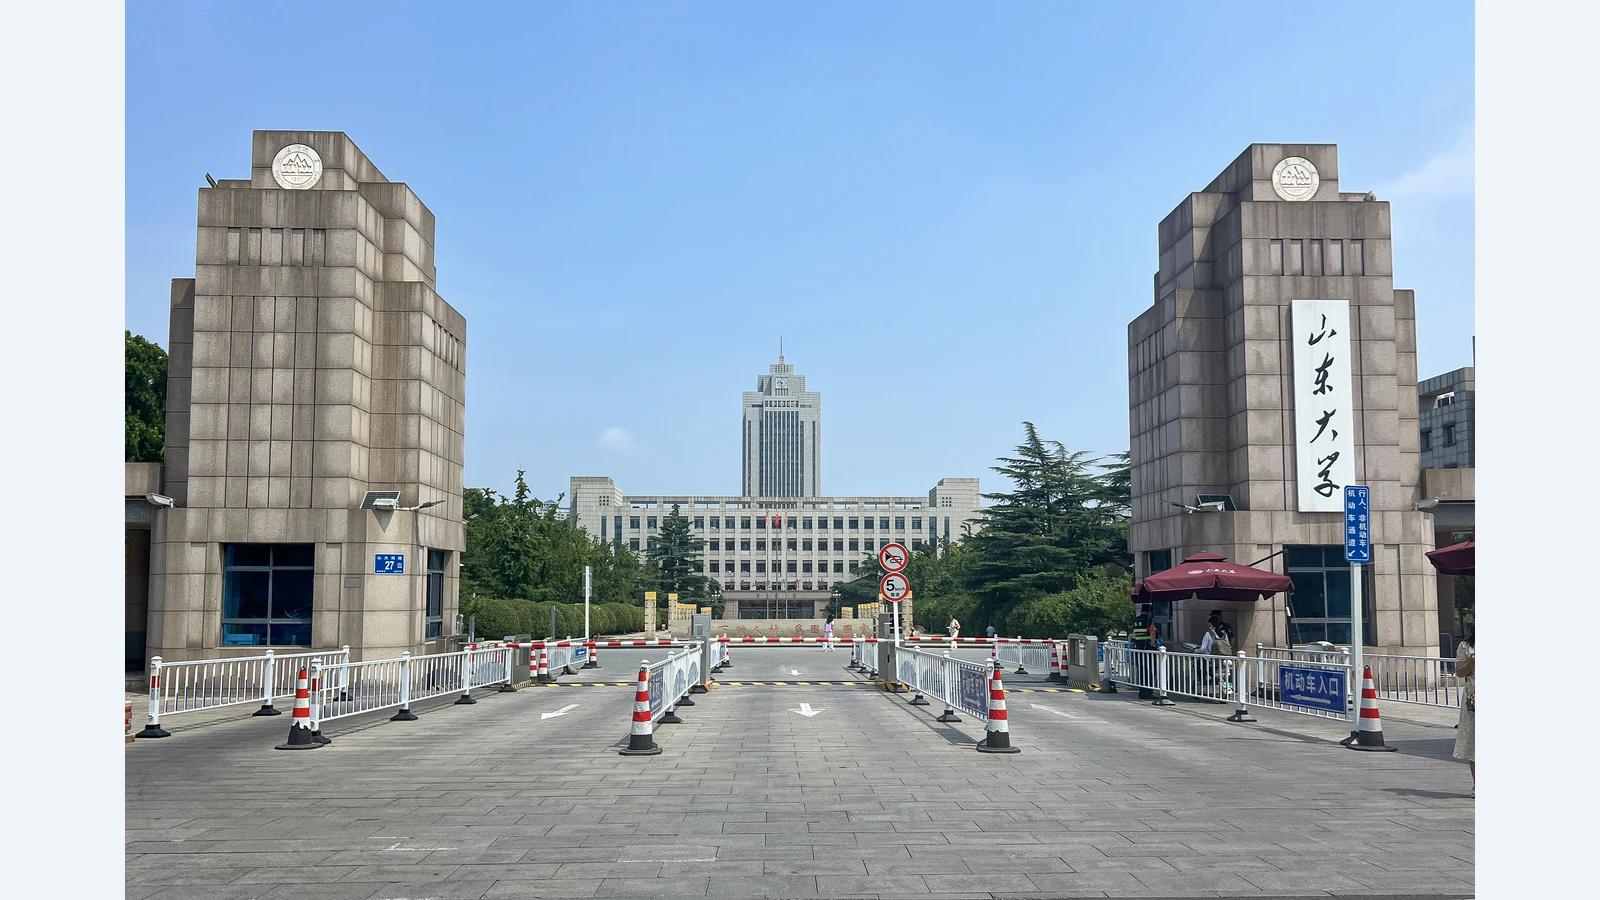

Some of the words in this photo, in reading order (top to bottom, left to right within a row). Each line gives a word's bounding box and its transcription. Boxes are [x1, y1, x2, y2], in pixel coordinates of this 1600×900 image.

[1308, 313, 1340, 497] 山东大学
[1347, 489, 1356, 547] 机动车通道
[1358, 489, 1367, 547] 行人、非机动车
[384, 560, 394, 570] 27
[886, 579, 895, 591] 5
[1284, 671, 1339, 696] 机动车入口
